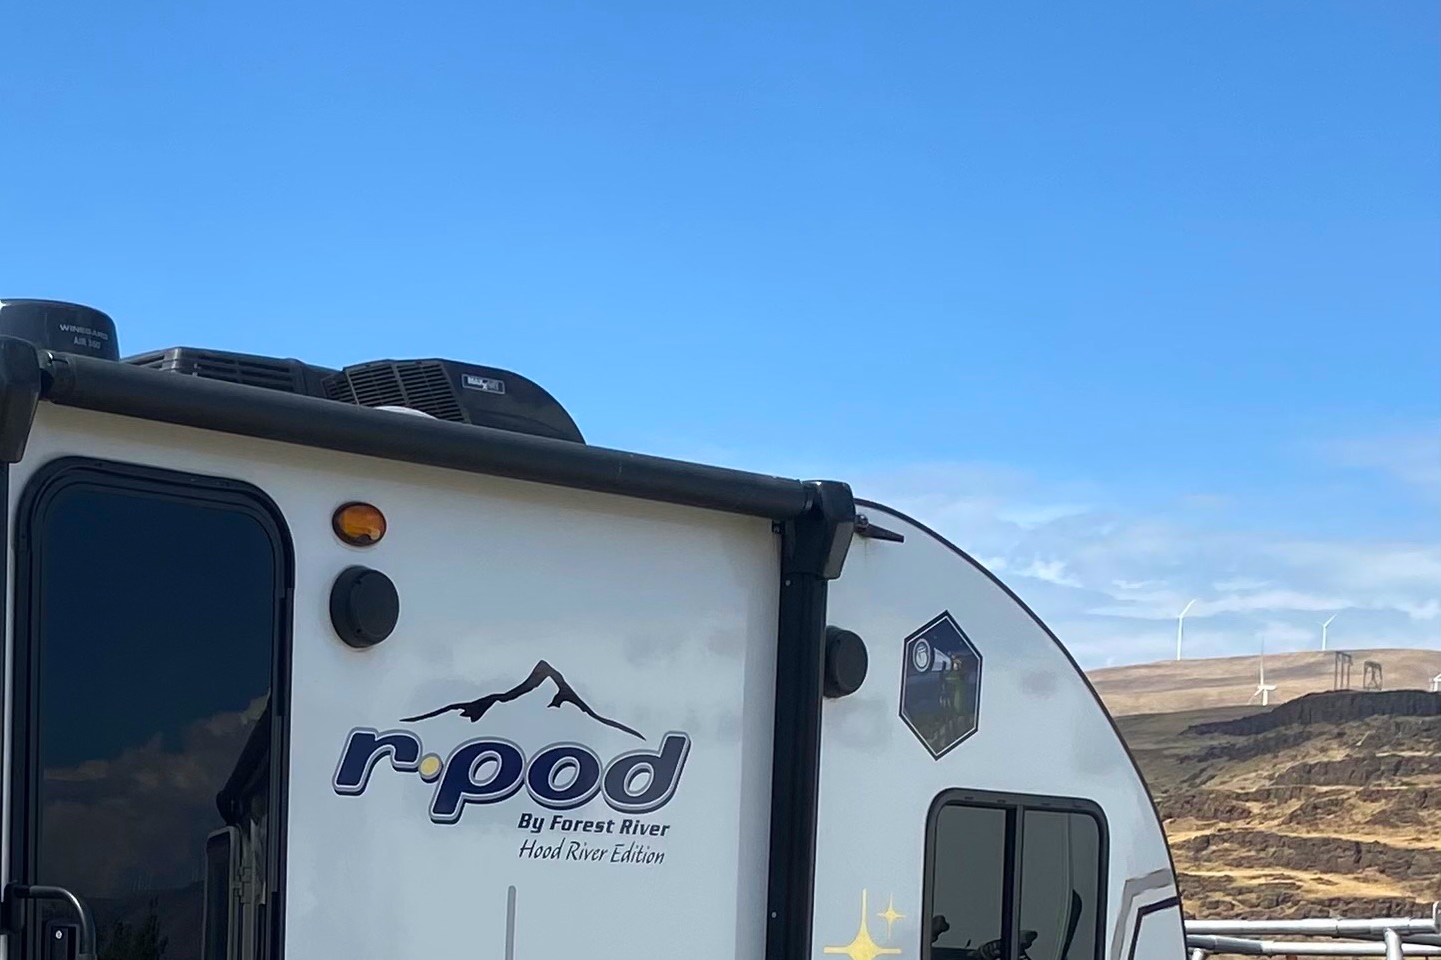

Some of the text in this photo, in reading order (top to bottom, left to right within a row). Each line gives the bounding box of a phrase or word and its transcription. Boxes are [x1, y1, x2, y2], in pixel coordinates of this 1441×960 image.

[517, 813, 671, 838] By Forest River
[518, 838, 666, 865] Hood River Edition
